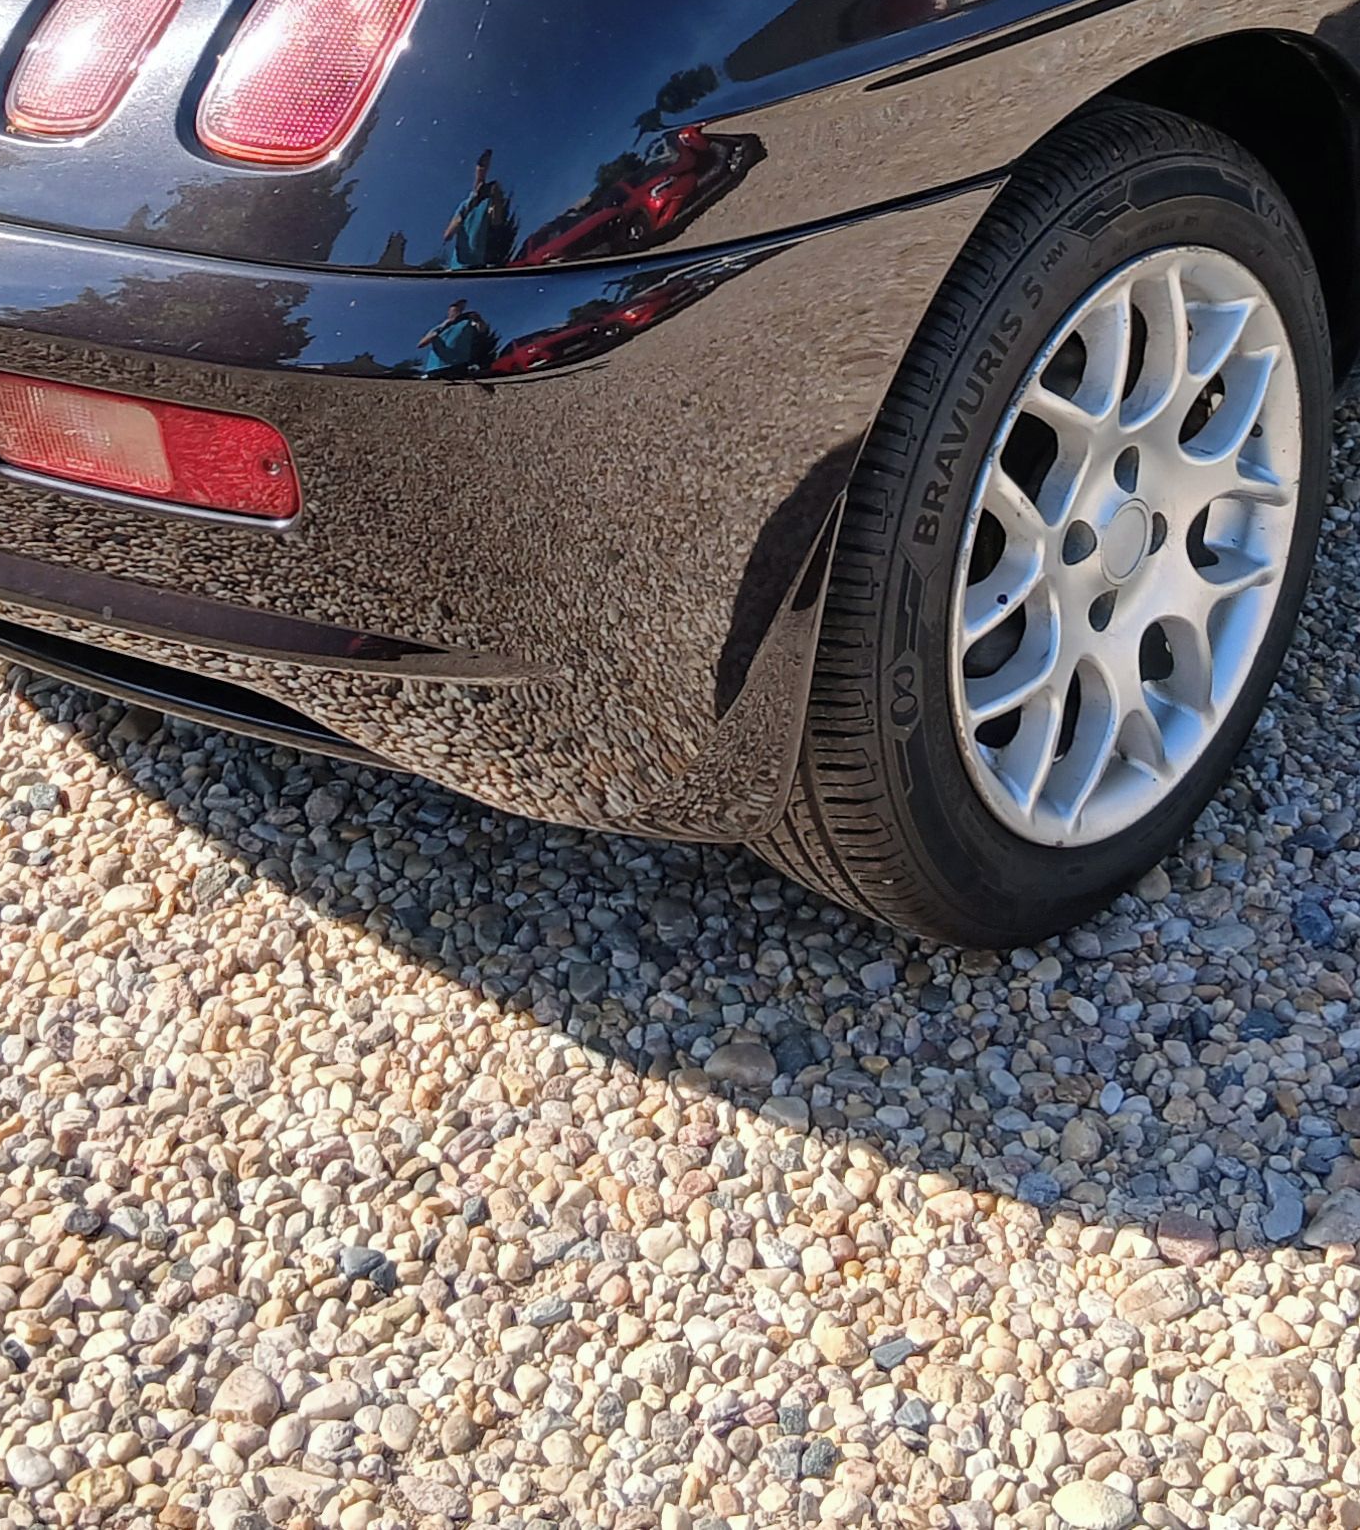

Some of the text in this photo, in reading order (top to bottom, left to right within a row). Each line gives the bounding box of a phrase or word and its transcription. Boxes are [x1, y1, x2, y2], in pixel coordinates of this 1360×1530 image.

[912, 241, 1069, 546] BRAVURIS 5 HM
